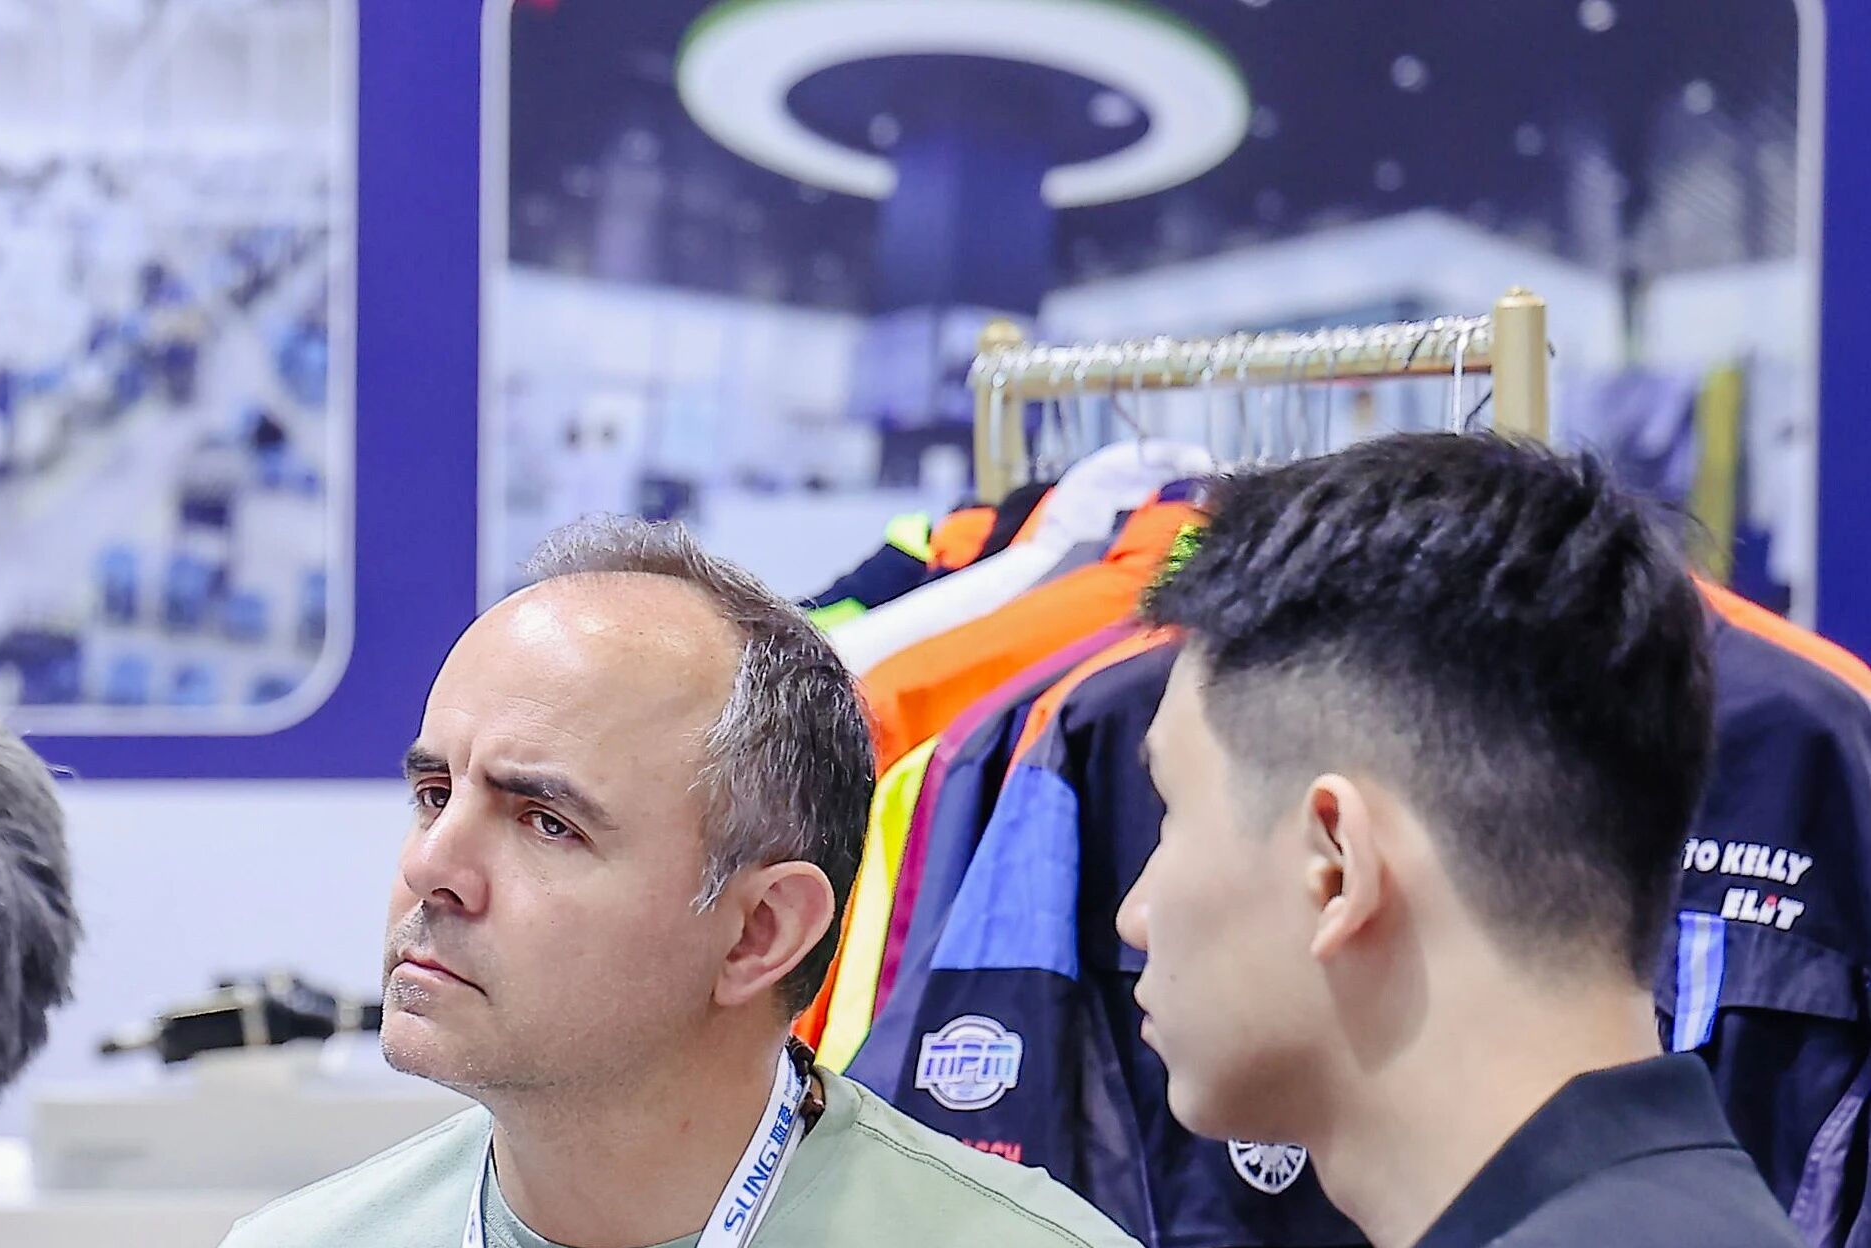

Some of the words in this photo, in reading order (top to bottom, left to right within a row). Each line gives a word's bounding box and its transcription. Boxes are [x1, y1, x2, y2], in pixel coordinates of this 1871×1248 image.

[1683, 838, 1719, 872] TO
[1720, 841, 1813, 885] KELLY
[724, 1144, 778, 1236] SLING
